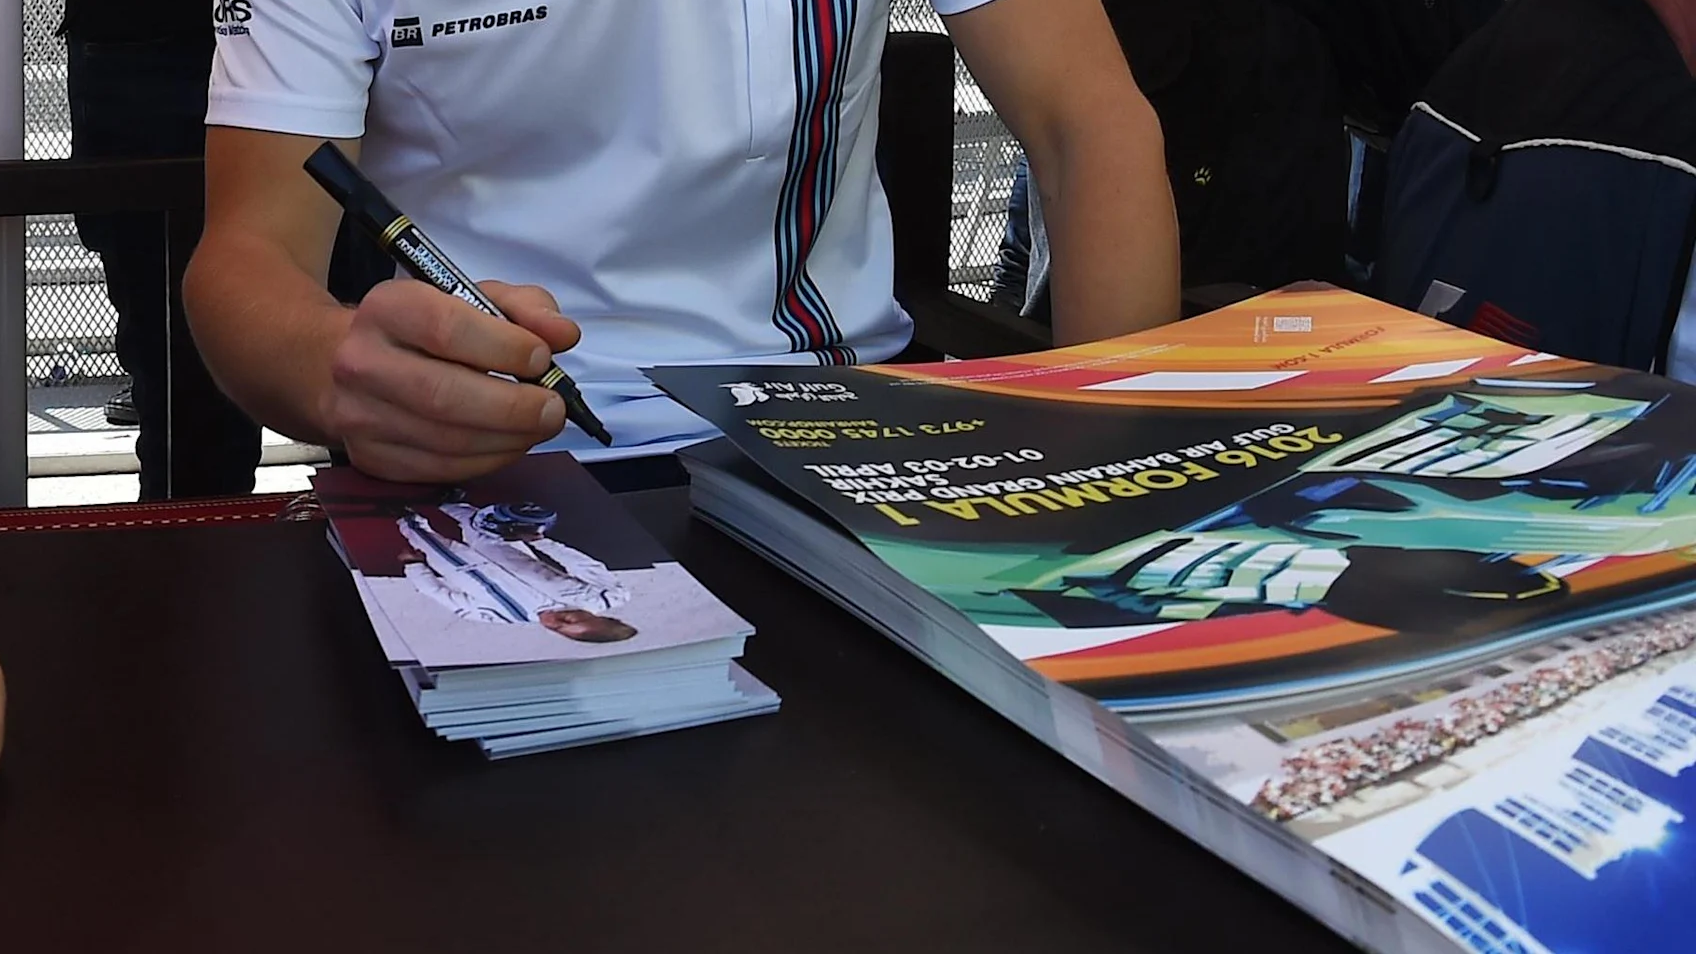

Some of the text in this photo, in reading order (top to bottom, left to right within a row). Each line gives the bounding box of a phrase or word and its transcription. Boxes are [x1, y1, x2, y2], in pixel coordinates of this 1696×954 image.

[393, 5, 548, 42] BR PETROBRAS
[763, 381, 847, 393] Gulf Air
[758, 418, 986, 440] +973 1745 0000
[803, 447, 1045, 477] 01-02-03 APRIL
[841, 423, 1296, 504] GULF AIR BAHRAIN GRAND PRIX
[874, 425, 1343, 526] 2016 FORMULA 1
[822, 474, 950, 491] SAKHIR
